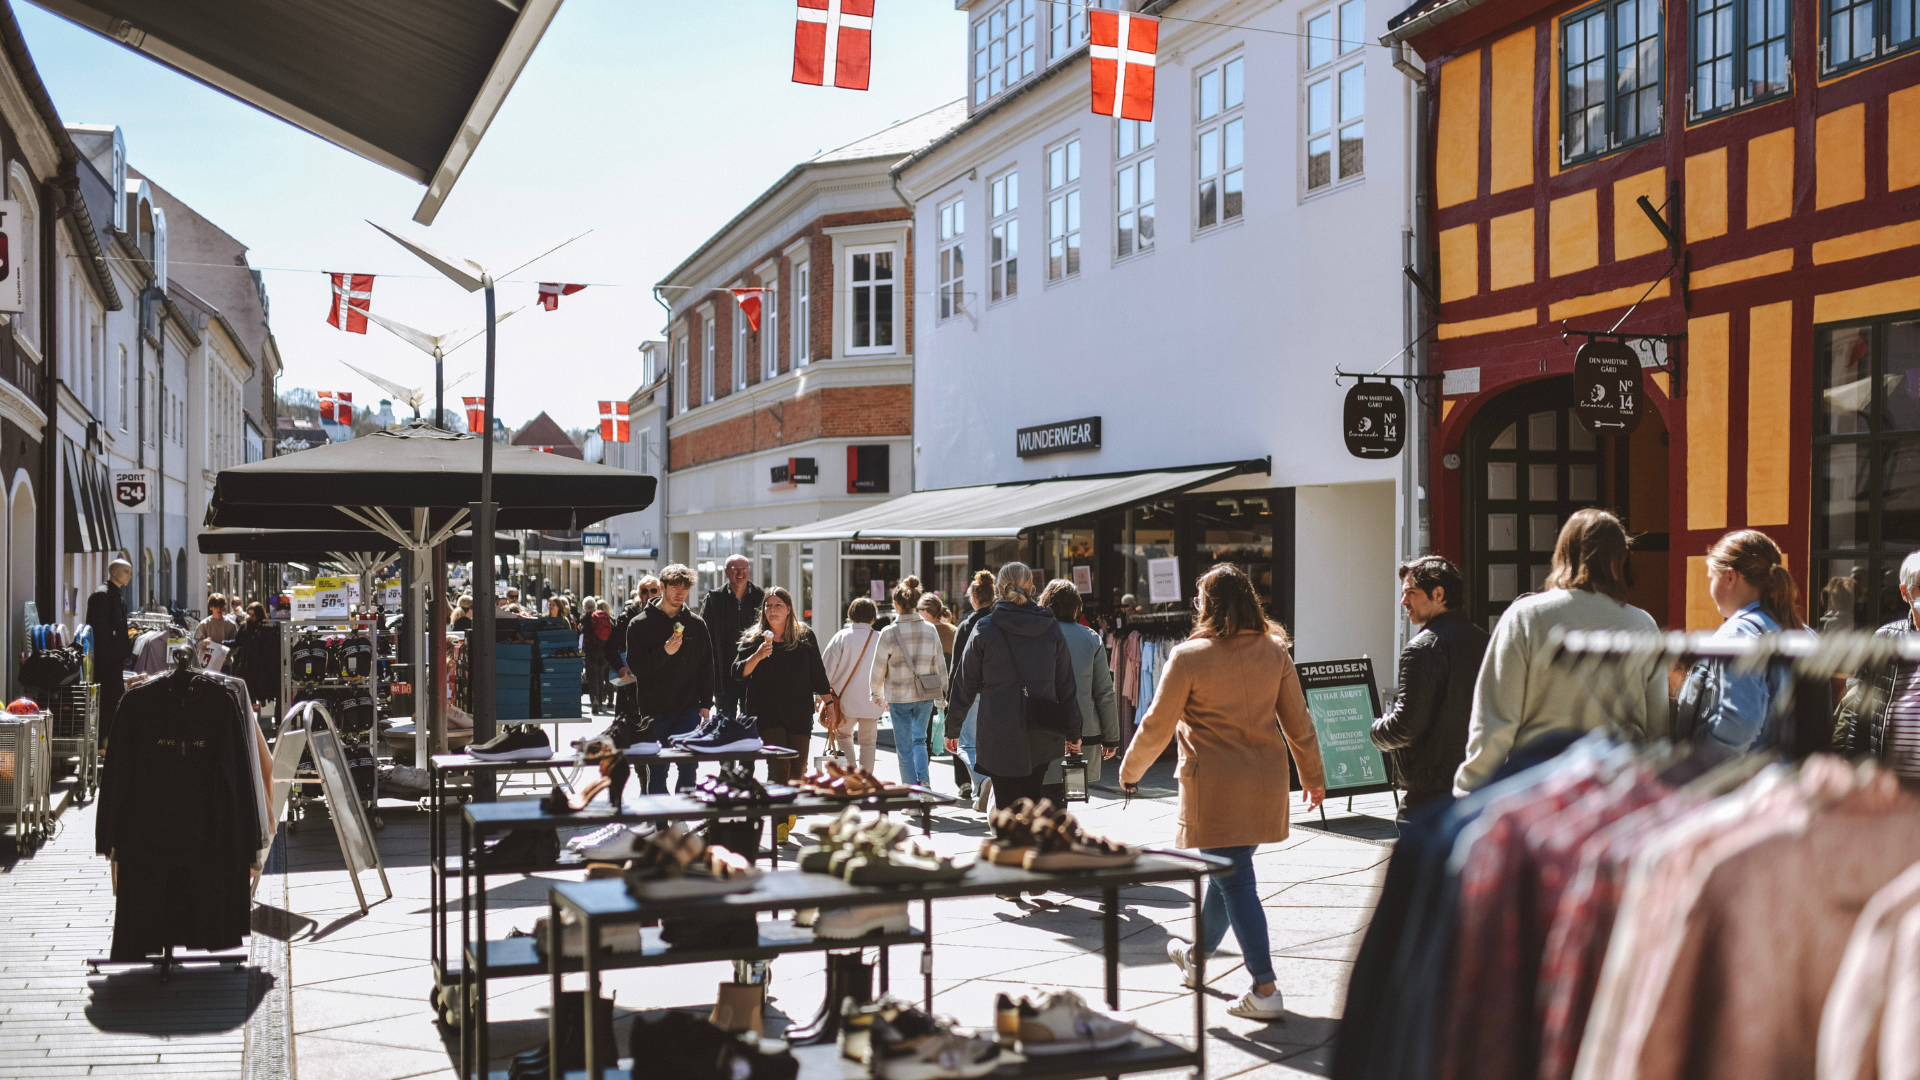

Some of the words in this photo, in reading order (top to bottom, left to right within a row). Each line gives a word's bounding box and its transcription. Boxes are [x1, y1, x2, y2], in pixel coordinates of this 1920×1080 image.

[1602, 358, 1628, 366] SMIDTSKE
[1600, 365, 1617, 373] GÅRD
[1619, 394, 1634, 410] 14
[1384, 425, 1397, 438] 14
[1018, 423, 1092, 452] WUNDERWEAR
[116, 473, 146, 481] SPORT
[120, 486, 144, 500] 24
[585, 535, 607, 545] matas
[850, 543, 891, 551] FIRMAGAVER
[321, 598, 345, 608] 50%
[1301, 662, 1368, 676] JACOBSEN
[1313, 693, 1323, 701] VI
[1323, 691, 1339, 700] HAR
[1340, 689, 1363, 699] ÅBENT
[1326, 707, 1358, 717] UDENFOR
[1330, 730, 1364, 741] INDENFOR
[1361, 766, 1373, 777] 14
